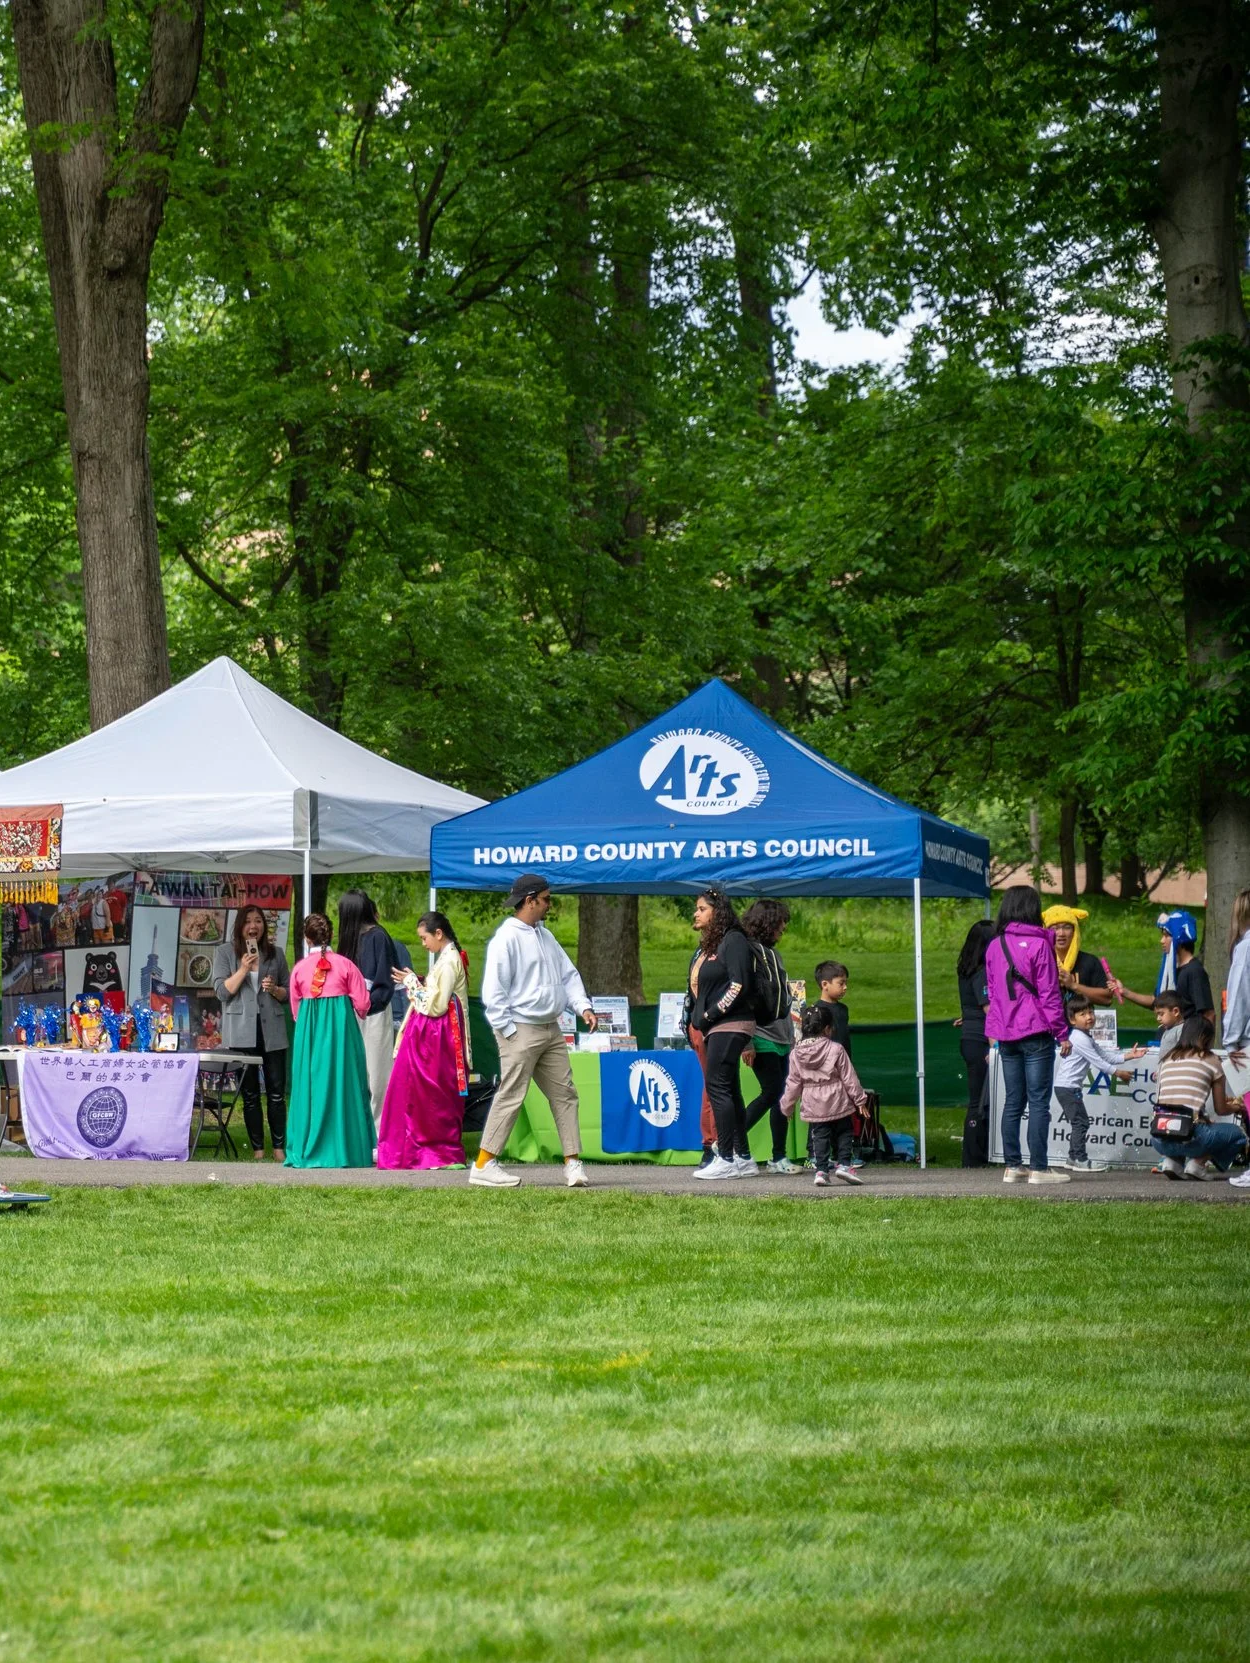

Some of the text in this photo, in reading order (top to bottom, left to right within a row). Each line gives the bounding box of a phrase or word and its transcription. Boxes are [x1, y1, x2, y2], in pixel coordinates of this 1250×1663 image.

[650, 744, 741, 800] Arts
[686, 800, 740, 808] COUNCIL
[474, 838, 876, 865] HOWARD COUNTY ARTS COUNCIL
[139, 881, 289, 898] TAIWAN TAI-HOW
[637, 1070, 669, 1113] Arts
[1058, 1112, 1133, 1128] Aerican
